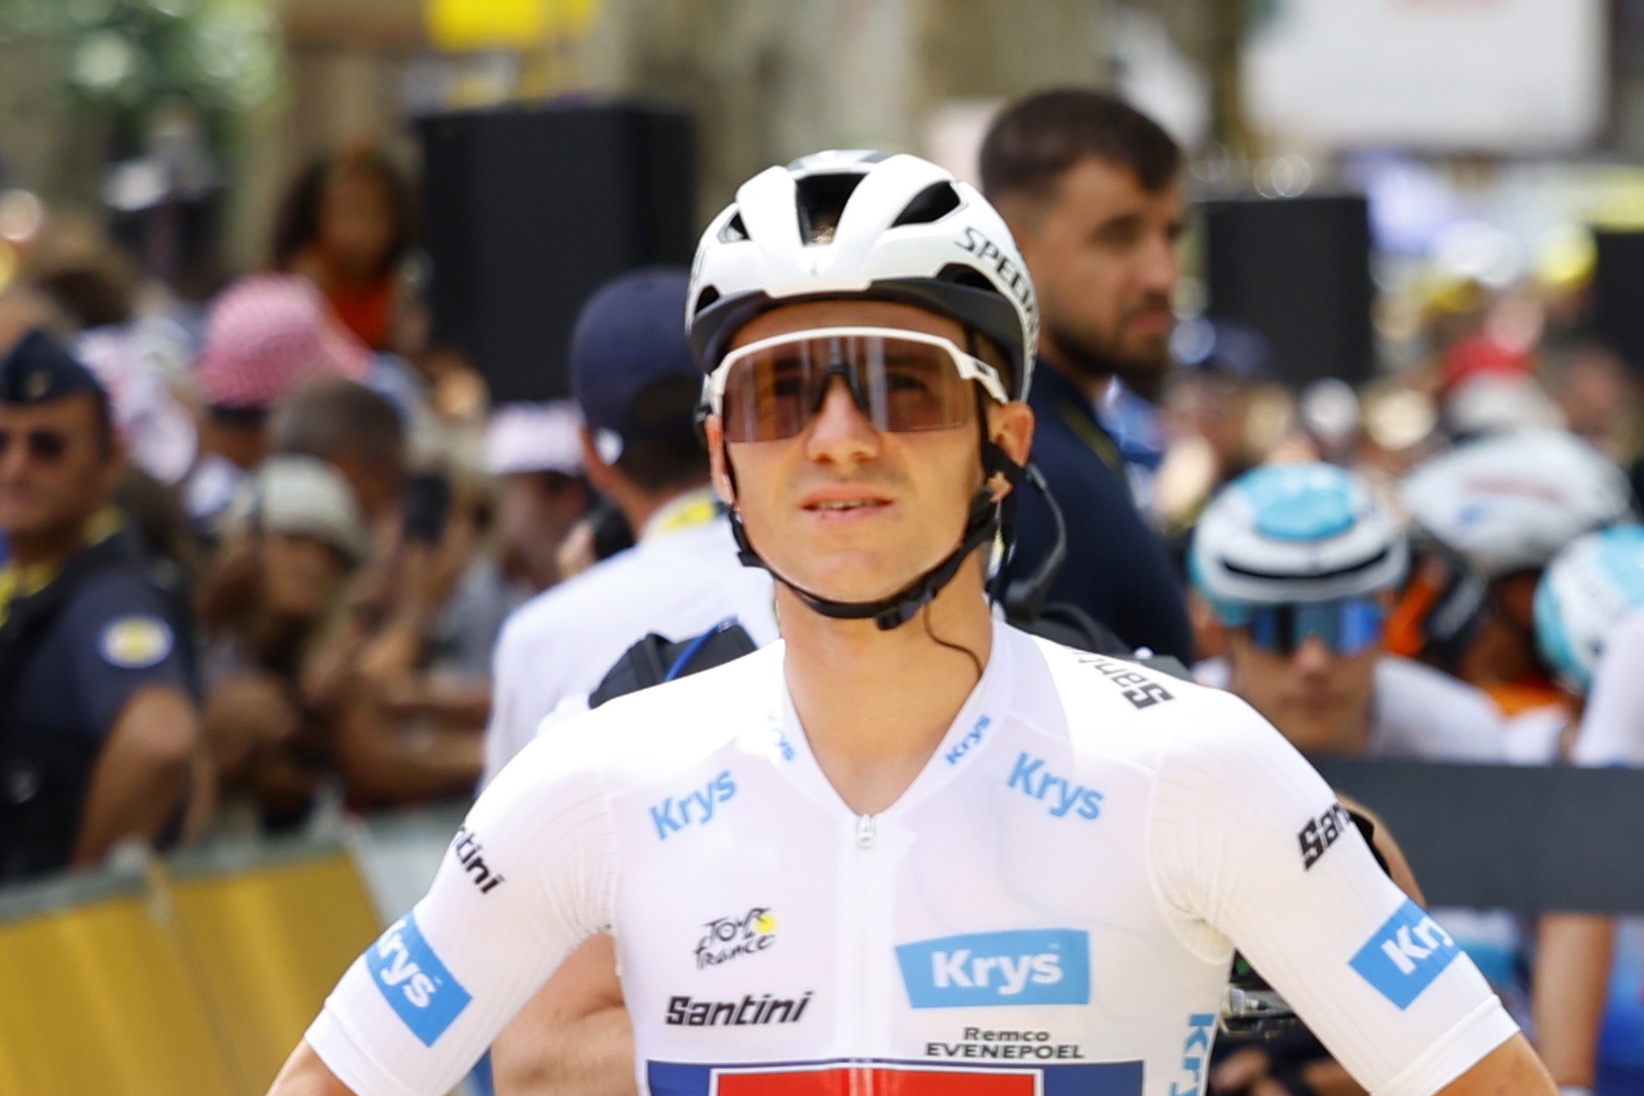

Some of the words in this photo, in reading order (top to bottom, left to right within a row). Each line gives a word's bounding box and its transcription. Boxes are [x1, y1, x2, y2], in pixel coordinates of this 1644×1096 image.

[945, 714, 993, 766] Krys
[650, 768, 738, 842] Krys
[1006, 751, 1106, 821] Krys
[374, 918, 438, 1010] rys
[930, 949, 1063, 996] Krys
[665, 988, 815, 1026] Santini
[925, 1042, 1086, 1059] EVENEPOEL
[964, 1027, 1050, 1043] Remco
